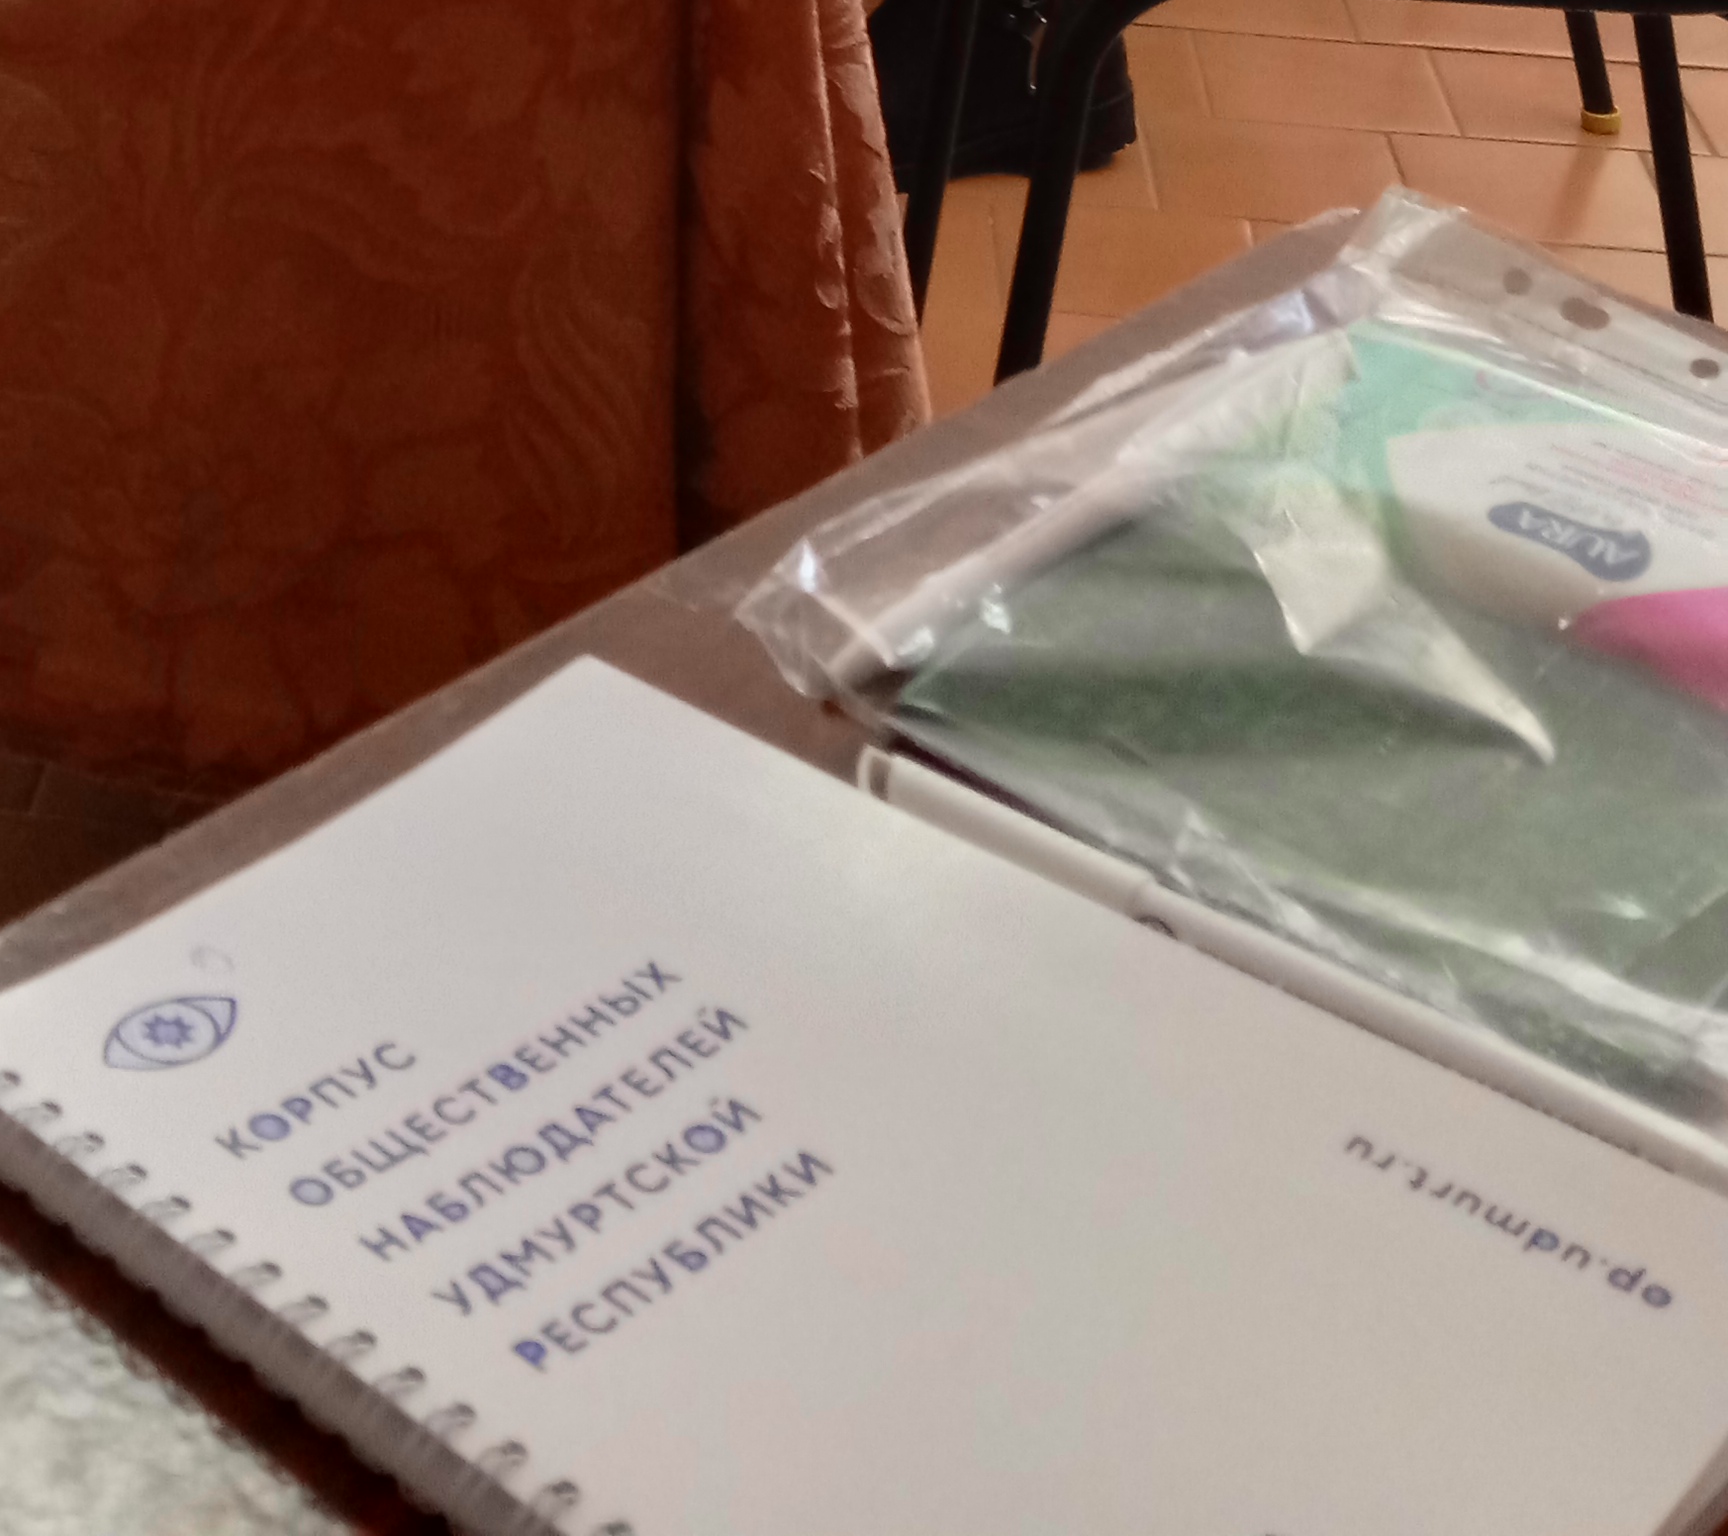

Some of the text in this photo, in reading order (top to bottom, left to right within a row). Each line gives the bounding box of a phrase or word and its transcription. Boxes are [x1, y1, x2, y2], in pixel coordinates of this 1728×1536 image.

[1518, 510, 1640, 566] AURA
[215, 1040, 418, 1160] КОРПУС
[289, 961, 682, 1208] ОБЩЕСТВЕННЫХ
[358, 1005, 751, 1262] НАБЛЮДАТЕЛЕЙ
[431, 1095, 764, 1317] УДМУРТСКОЙ
[512, 1149, 836, 1373] РЕСПУБЛИКИ
[1344, 1134, 1673, 1309] op.udmurt.ru
